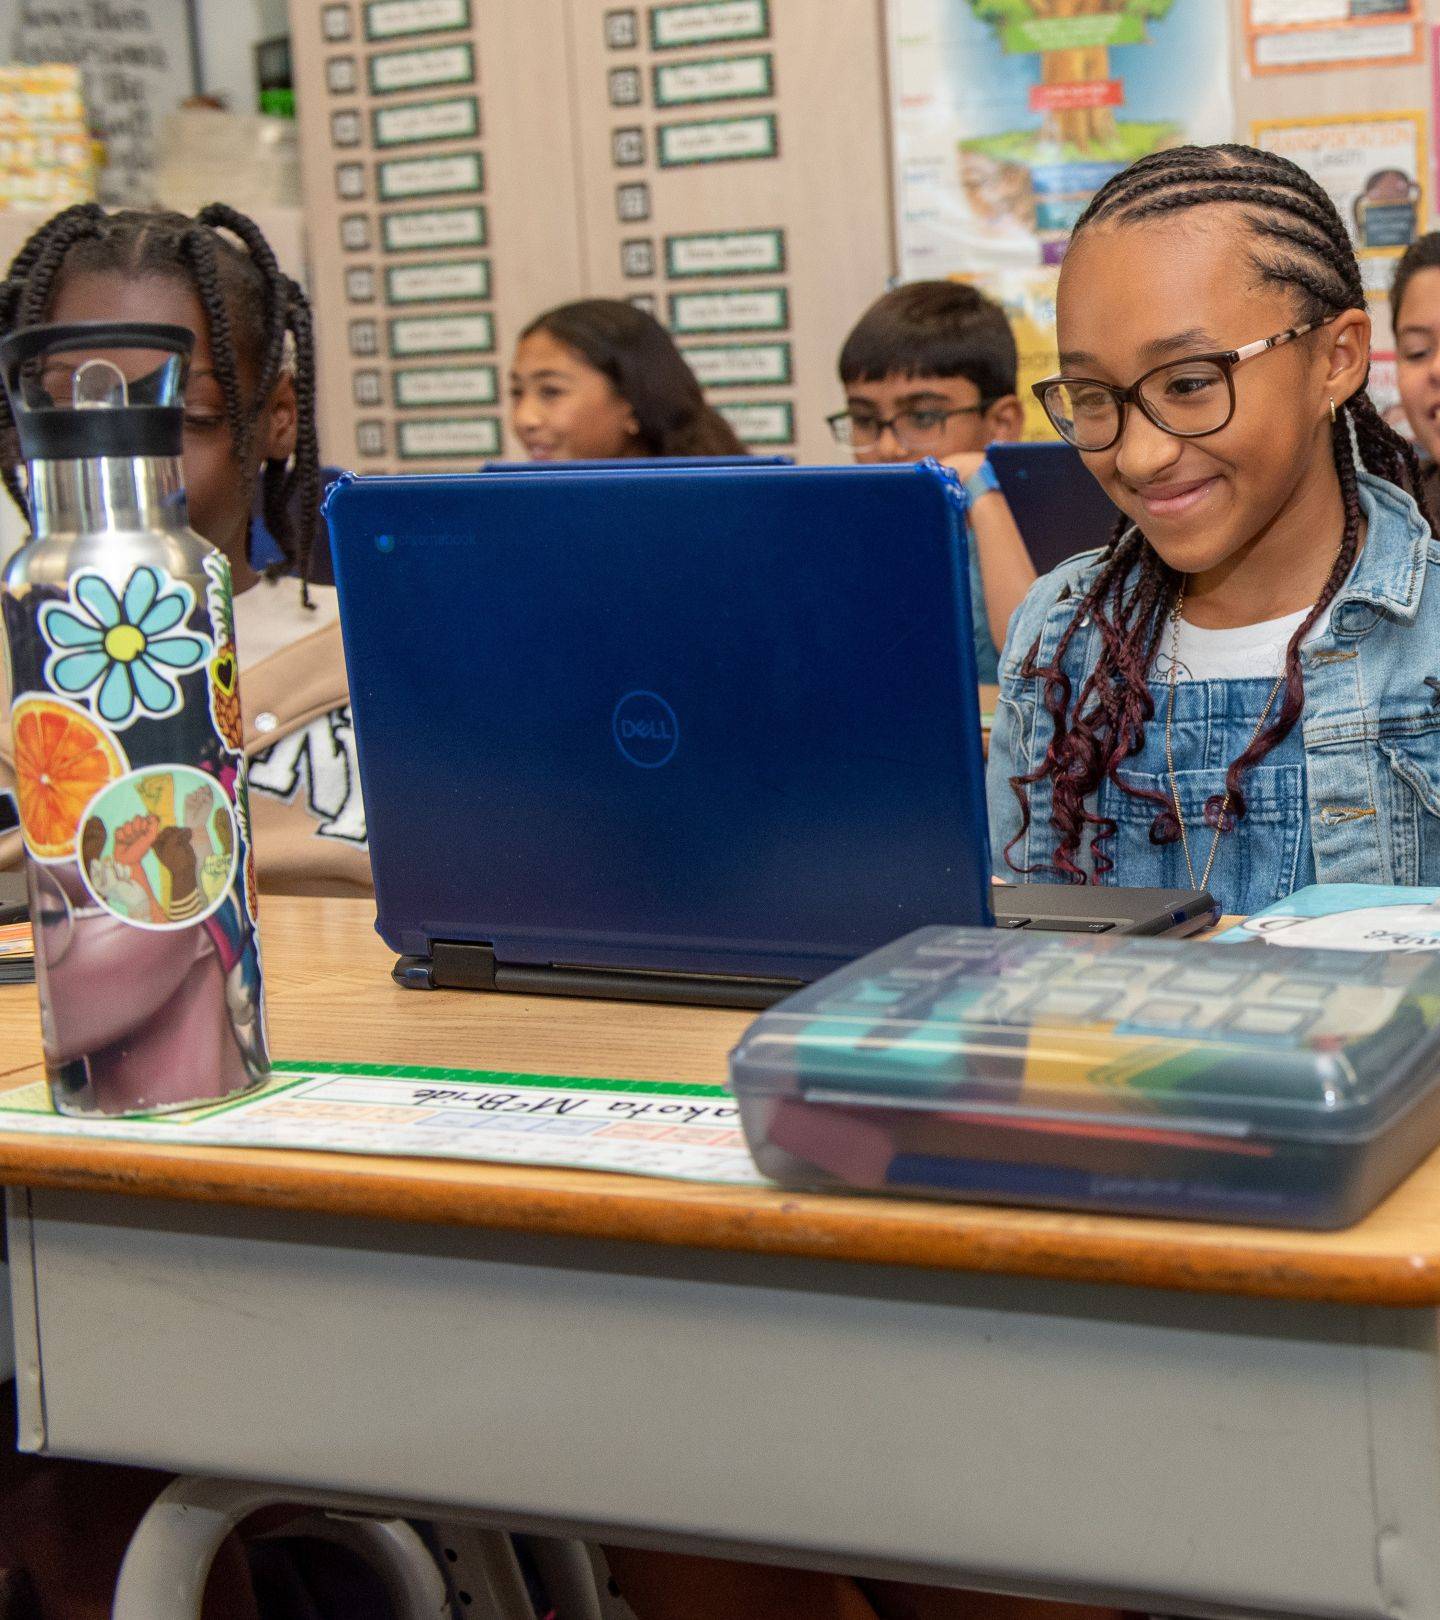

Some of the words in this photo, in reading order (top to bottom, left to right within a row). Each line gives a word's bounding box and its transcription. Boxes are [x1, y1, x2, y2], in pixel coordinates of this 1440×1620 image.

[621, 718, 673, 740] DELL
[411, 1088, 589, 1115] McBride
[607, 1100, 739, 1124] akota
